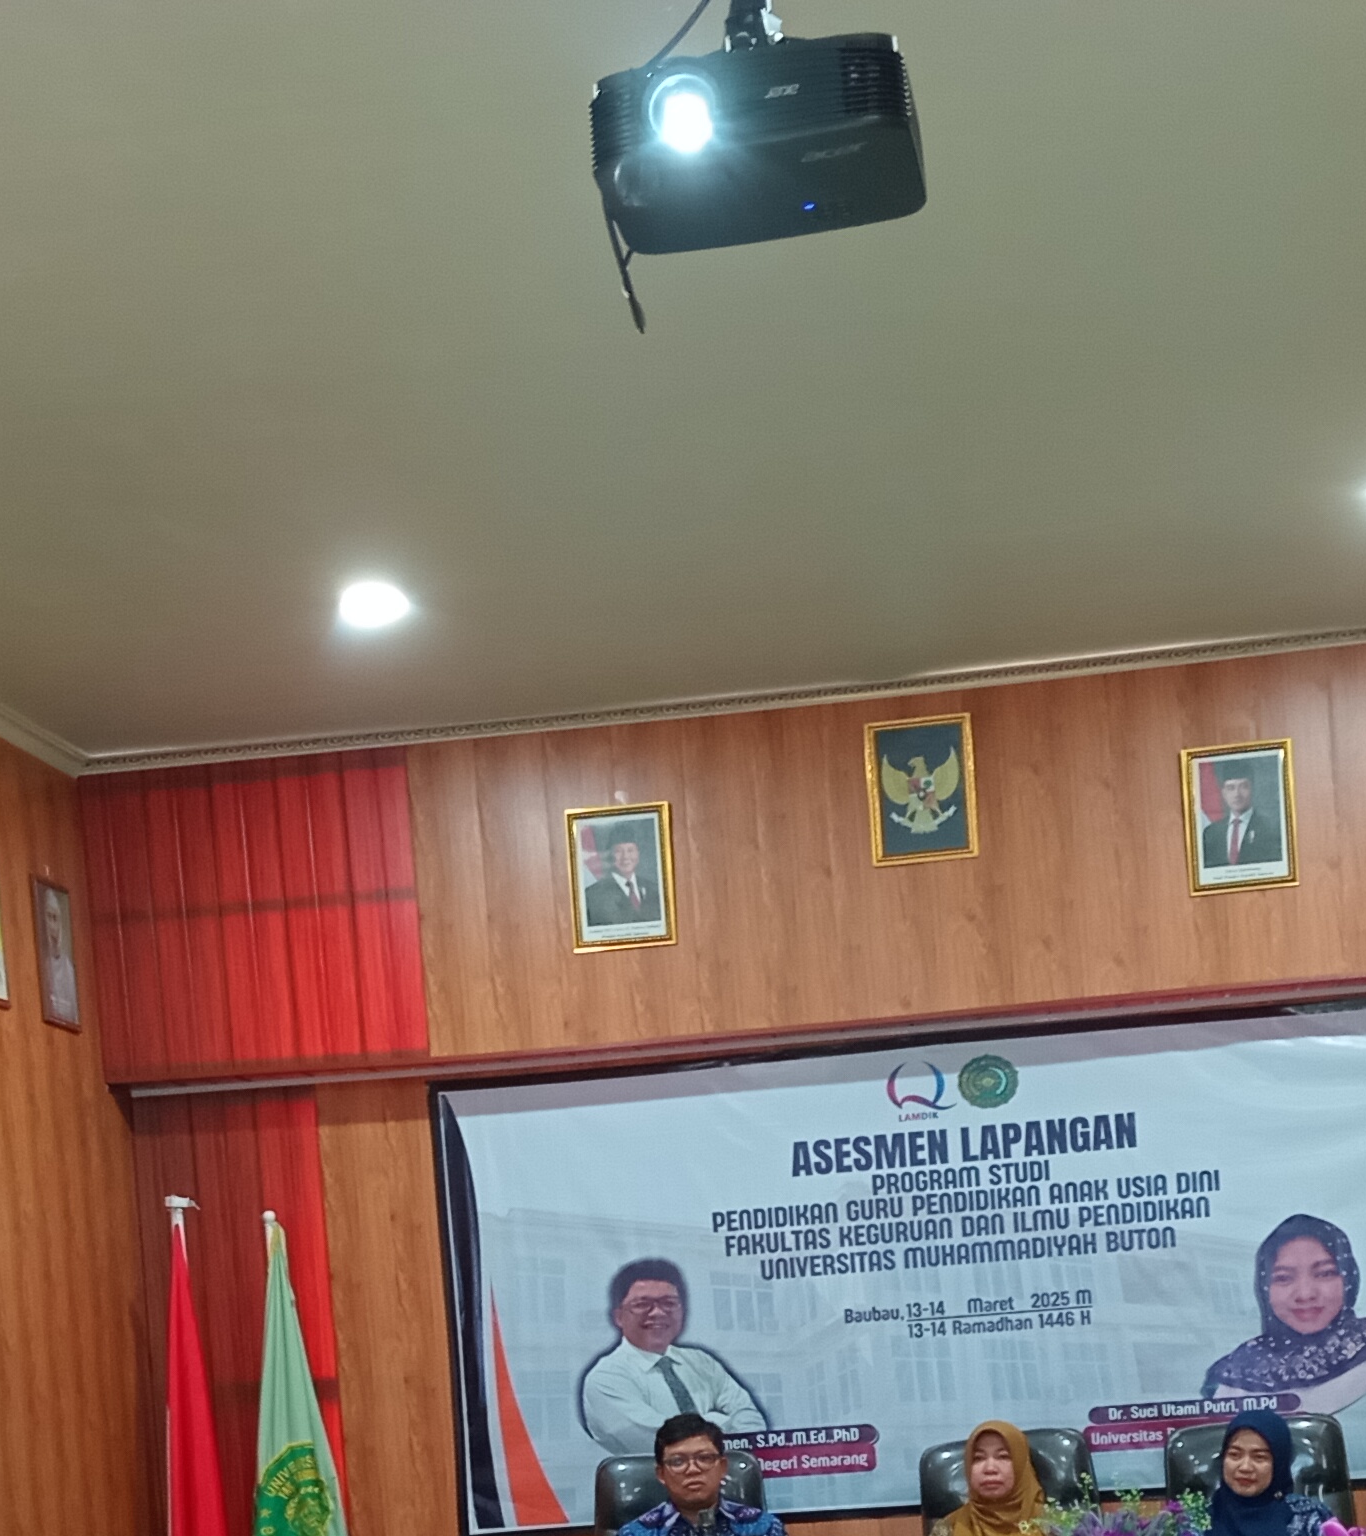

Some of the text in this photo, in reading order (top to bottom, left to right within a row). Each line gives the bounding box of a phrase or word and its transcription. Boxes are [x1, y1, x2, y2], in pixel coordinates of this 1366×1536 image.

[898, 1111, 939, 1123] LAMDIK
[791, 1112, 1137, 1177] ASESMEN LAPANGAN
[871, 1159, 1051, 1196] PROGRAM STUDI
[712, 1169, 1221, 1233] PENDIDIKAN GURU PENDIDIKAN ANAK USIA DINI
[725, 1196, 1211, 1257] FAKULTAS KEGURUAN DAN ILMU PENDIDIKAN
[760, 1226, 1177, 1281] UNIVERSITAS MUHAMMADIYAH BUTON
[906, 1300, 946, 1318] 13-14
[967, 1296, 1015, 1314] Maret
[1030, 1291, 1071, 1309] 2025
[1076, 1289, 1093, 1305] M
[907, 1310, 1092, 1338] 13-14 Ramadhan 1446 H
[1108, 1407, 1127, 1420] Dr.
[1130, 1404, 1158, 1419] Suci
[1162, 1402, 1200, 1417] Utami
[1243, 1396, 1278, 1412] M.Pd
[1090, 1430, 1164, 1446] Universitas
[801, 1452, 868, 1469] Semarang
